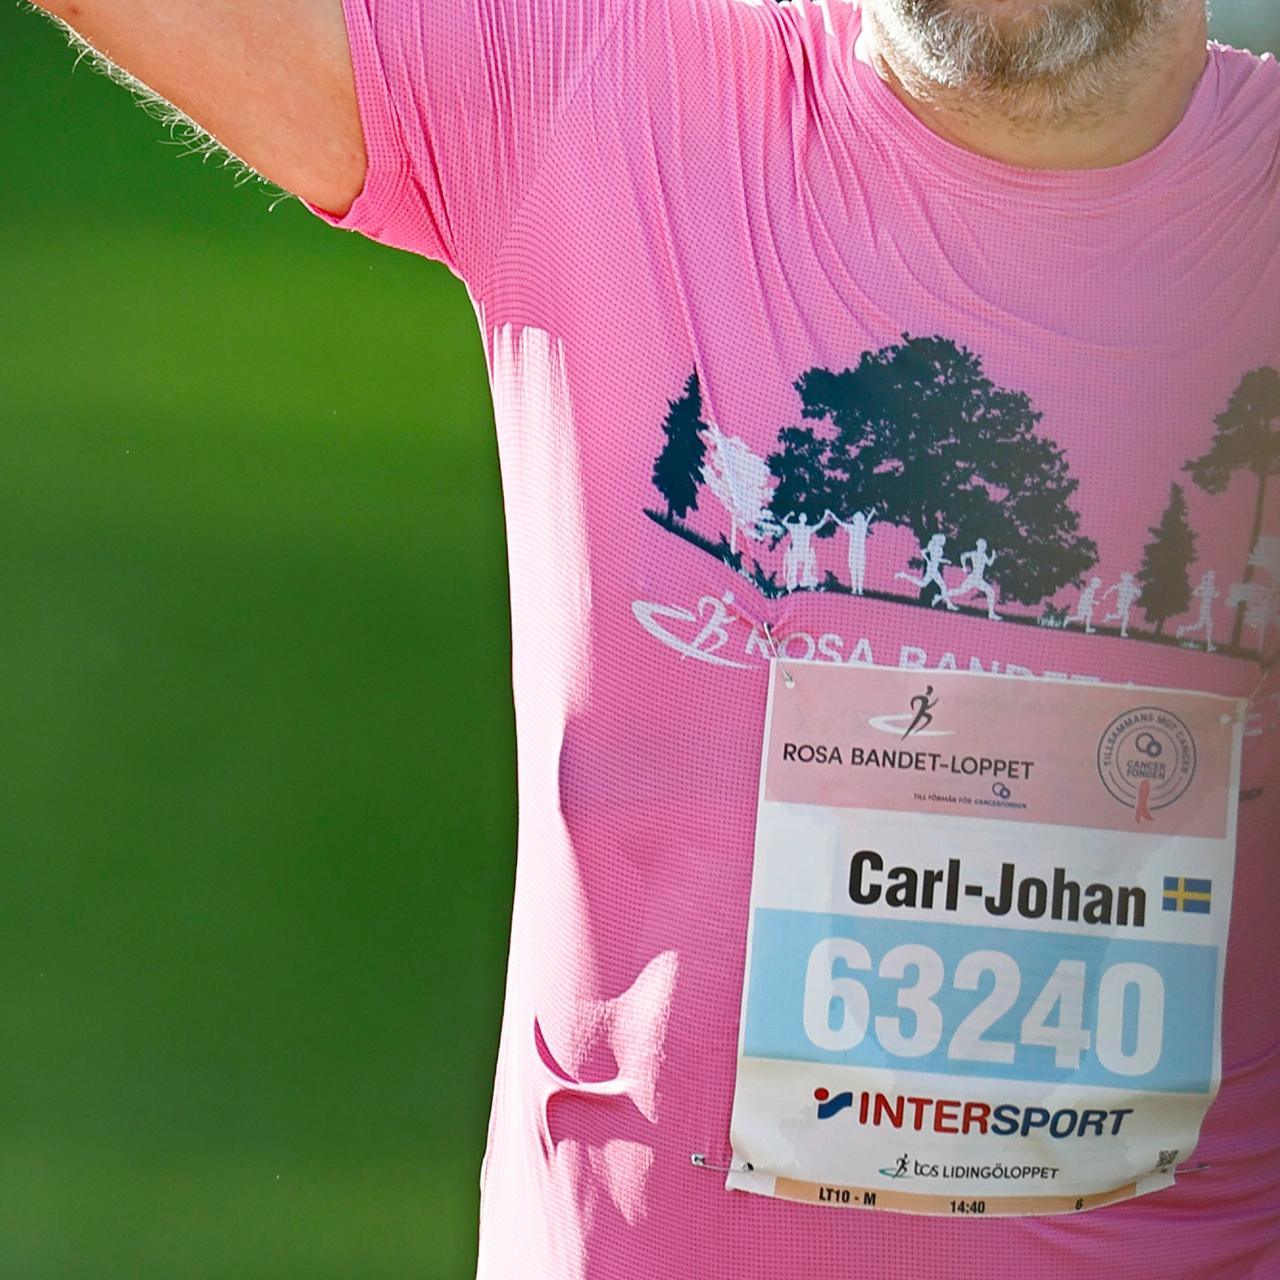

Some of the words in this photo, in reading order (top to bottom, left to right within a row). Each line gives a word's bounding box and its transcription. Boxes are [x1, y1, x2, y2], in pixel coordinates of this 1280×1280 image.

[783, 742, 843, 765] ROSA
[851, 747, 1034, 780] BANDET-LOPPET
[848, 850, 1146, 927] Carl-Johan
[803, 936, 1165, 1076] 63240
[859, 1091, 1134, 1139] INTERSPORT
[943, 1163, 1060, 1180] LIDINGÖLOPPET
[819, 1187, 850, 1204] LT10
[863, 1192, 877, 1206] M
[950, 1200, 986, 1214] 14:40
[1075, 1198, 1083, 1210] 6
